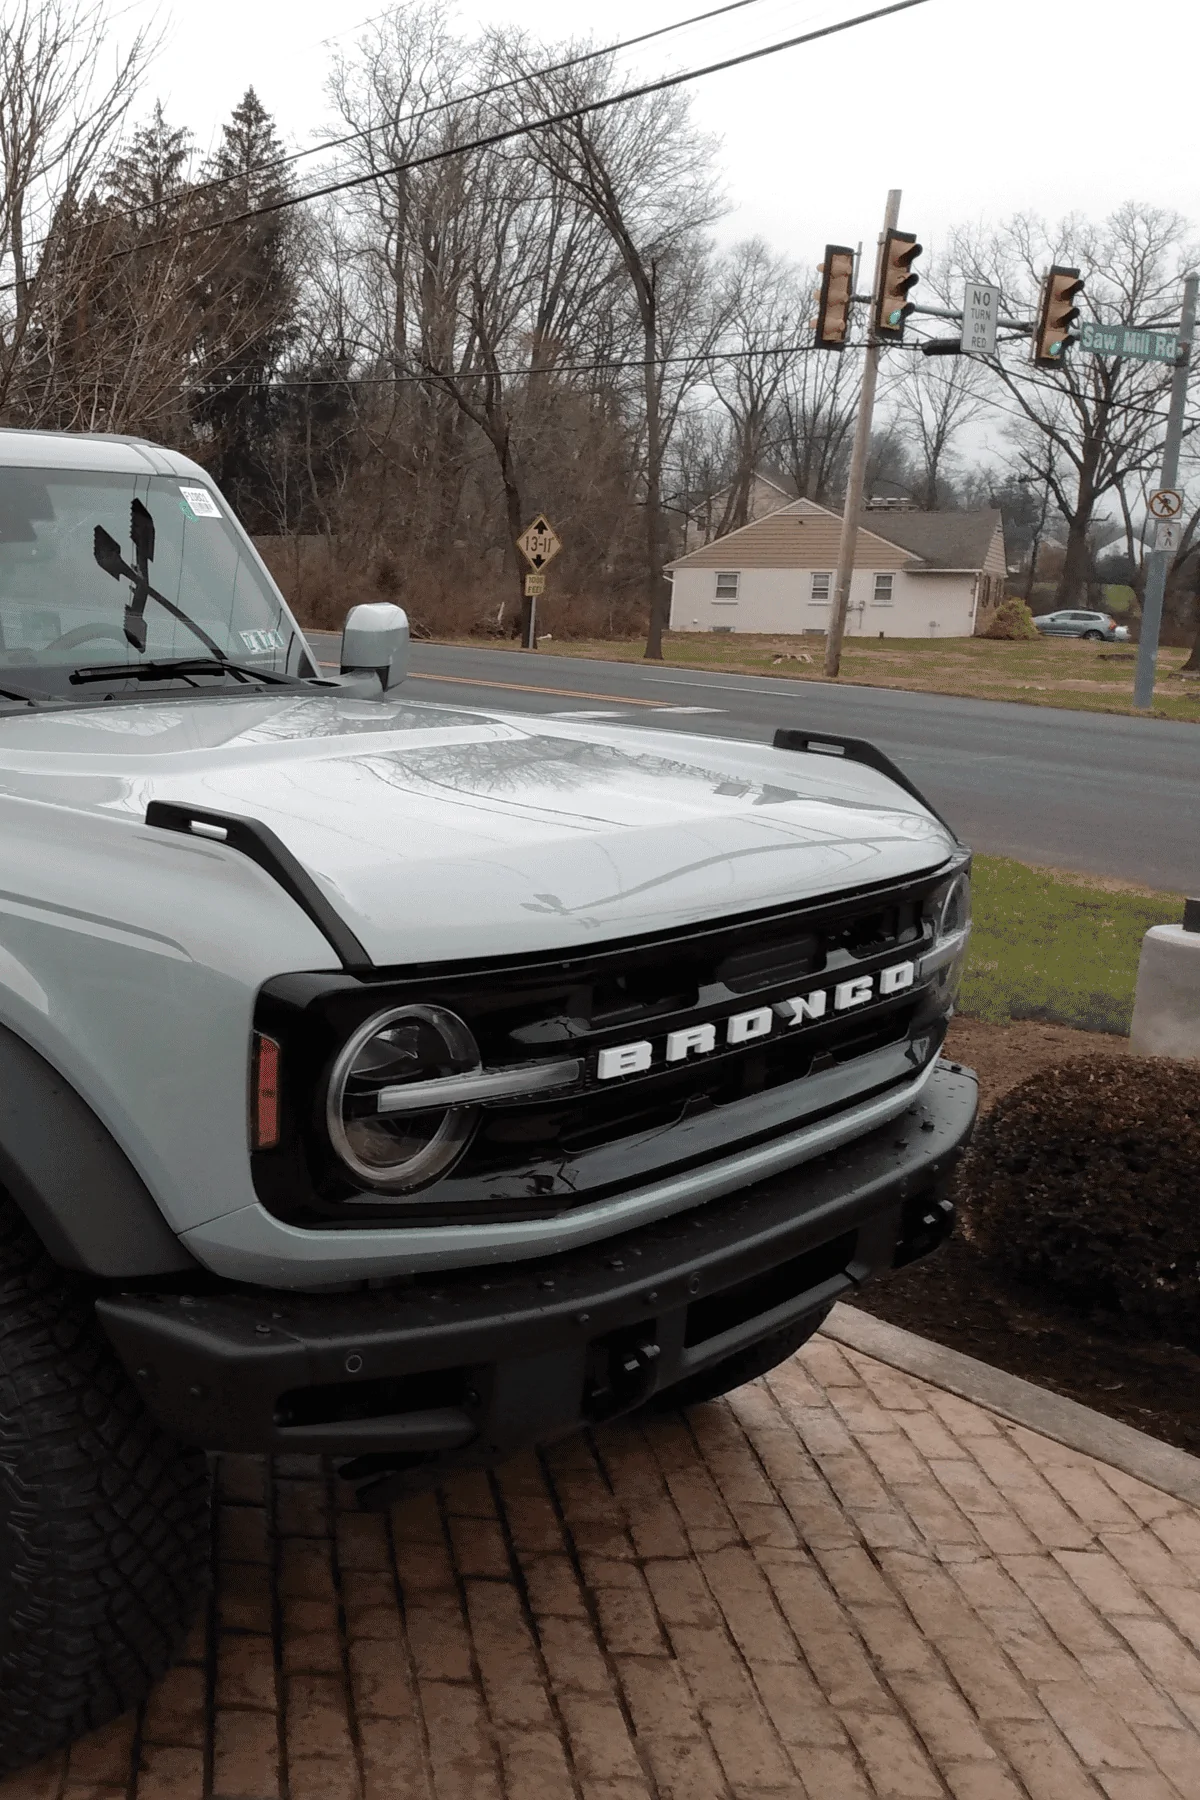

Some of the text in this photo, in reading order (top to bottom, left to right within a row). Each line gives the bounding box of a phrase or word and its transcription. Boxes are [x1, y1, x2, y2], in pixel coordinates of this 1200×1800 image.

[973, 290, 991, 306] NO
[971, 308, 991, 320] TURN
[974, 323, 986, 334] ON
[971, 336, 987, 348] RED
[1082, 325, 1177, 359] Saw Mill Rd
[597, 960, 915, 1079] BRONCO
